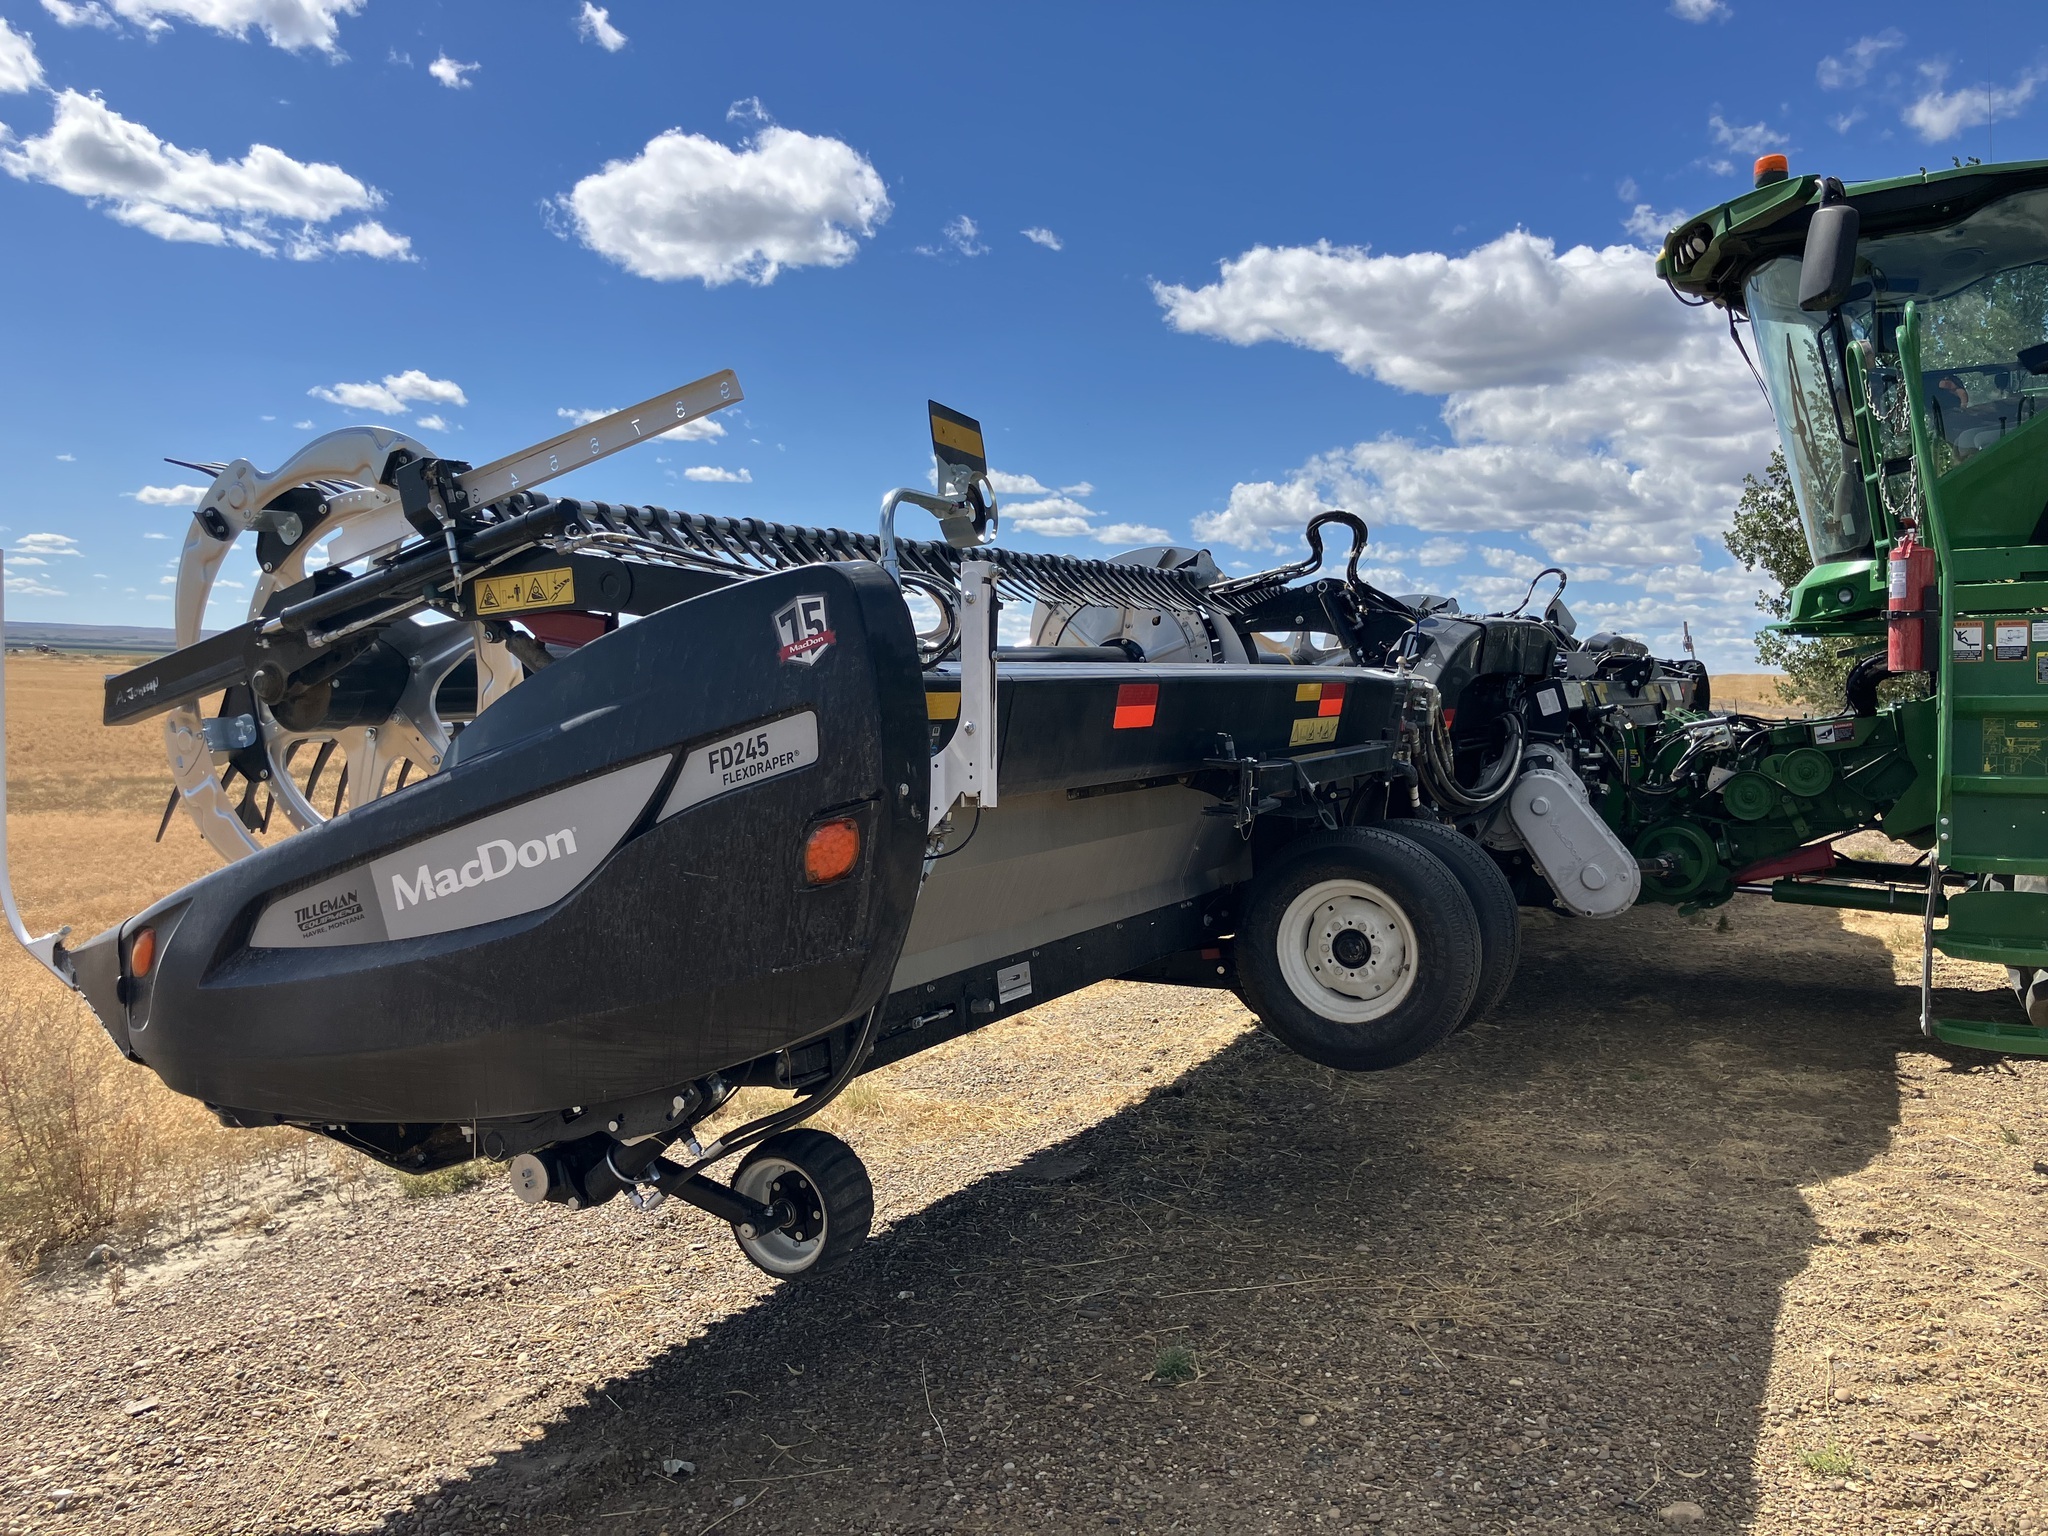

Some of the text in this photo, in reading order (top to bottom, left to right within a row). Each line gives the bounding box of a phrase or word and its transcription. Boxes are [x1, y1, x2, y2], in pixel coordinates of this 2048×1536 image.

[789, 636, 824, 654] MacDon
[708, 733, 769, 774] FD245
[294, 889, 358, 923] TILLEMAN
[299, 905, 361, 932] EQUIPMENT
[328, 914, 365, 931] MONTANA
